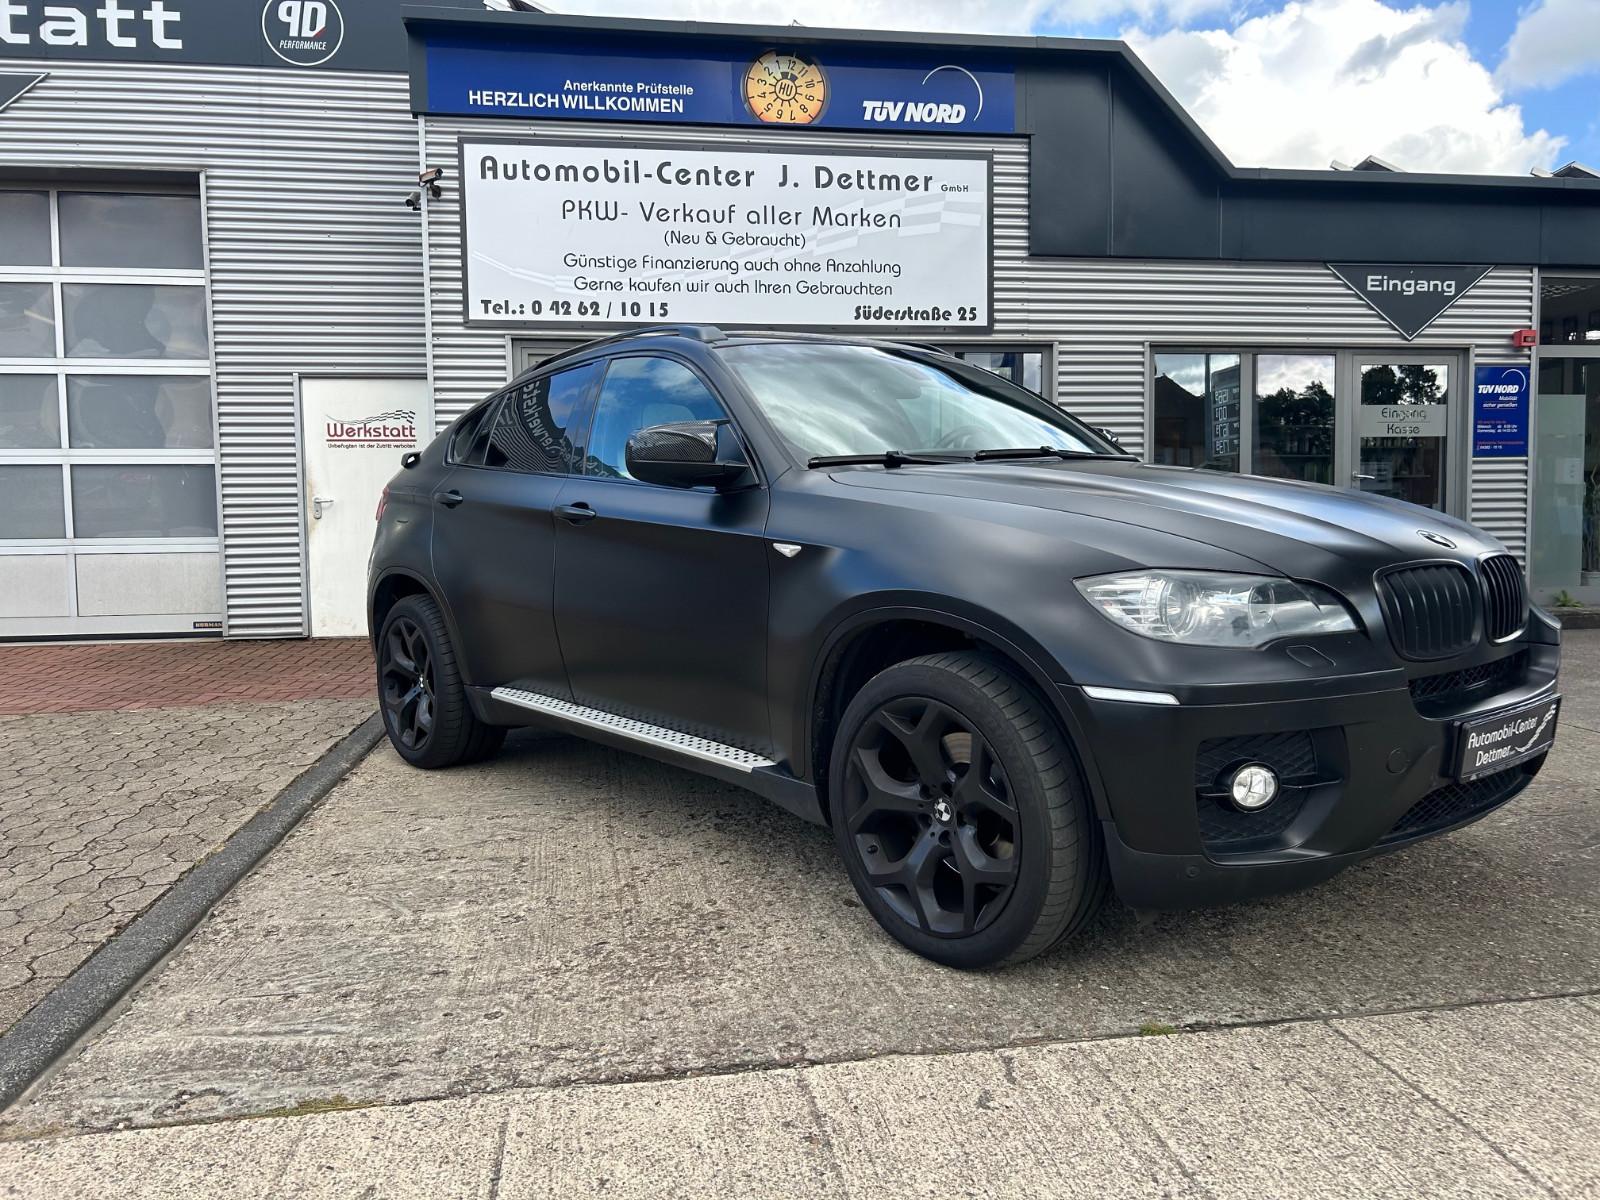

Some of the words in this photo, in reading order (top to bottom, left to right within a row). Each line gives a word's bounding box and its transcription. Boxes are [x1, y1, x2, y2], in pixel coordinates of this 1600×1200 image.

[280, 40, 327, 50] PERFORMANCE
[564, 79, 633, 93] Anerkannte
[637, 82, 694, 96] Prüfstelle
[778, 82, 793, 97] HU
[468, 90, 559, 109] HERZLICH
[562, 94, 684, 113] WILLKOMMEN
[862, 100, 905, 122] TÜV
[904, 102, 966, 124] NORD
[480, 155, 755, 188] Automobil-Center
[778, 164, 799, 188] J.
[815, 166, 933, 192] Dettmer
[940, 184, 969, 193] GmbH
[562, 199, 628, 222] PKW-
[639, 202, 736, 226] Verkauf
[746, 205, 803, 227] aller
[812, 206, 902, 229] Marken
[663, 230, 701, 247] (Neu
[705, 232, 717, 245] &
[722, 232, 806, 250] Gebraucht)
[563, 252, 638, 273] Günstige
[642, 255, 739, 275] Finanzierung
[744, 257, 779, 273] auch
[784, 258, 821, 273] ohne
[826, 259, 902, 279] Anzahlung
[573, 276, 624, 292] Gerne
[629, 277, 682, 293] kaufen
[686, 280, 711, 293] wir
[714, 279, 750, 294] auch
[755, 280, 792, 295] Ihren
[796, 280, 893, 296] Gebrauchten
[1366, 275, 1456, 295] Eingang
[480, 299, 525, 315] Tel.:
[854, 304, 952, 322] Süderstraße
[957, 307, 977, 322] 25
[1494, 384, 1519, 394] NORD
[1381, 408, 1426, 421] Eingang
[326, 423, 416, 438] Werkstatt
[1387, 424, 1420, 434] Kasse
[1468, 717, 1537, 748] Automobil-Center
[1475, 745, 1511, 766] Dettmer
